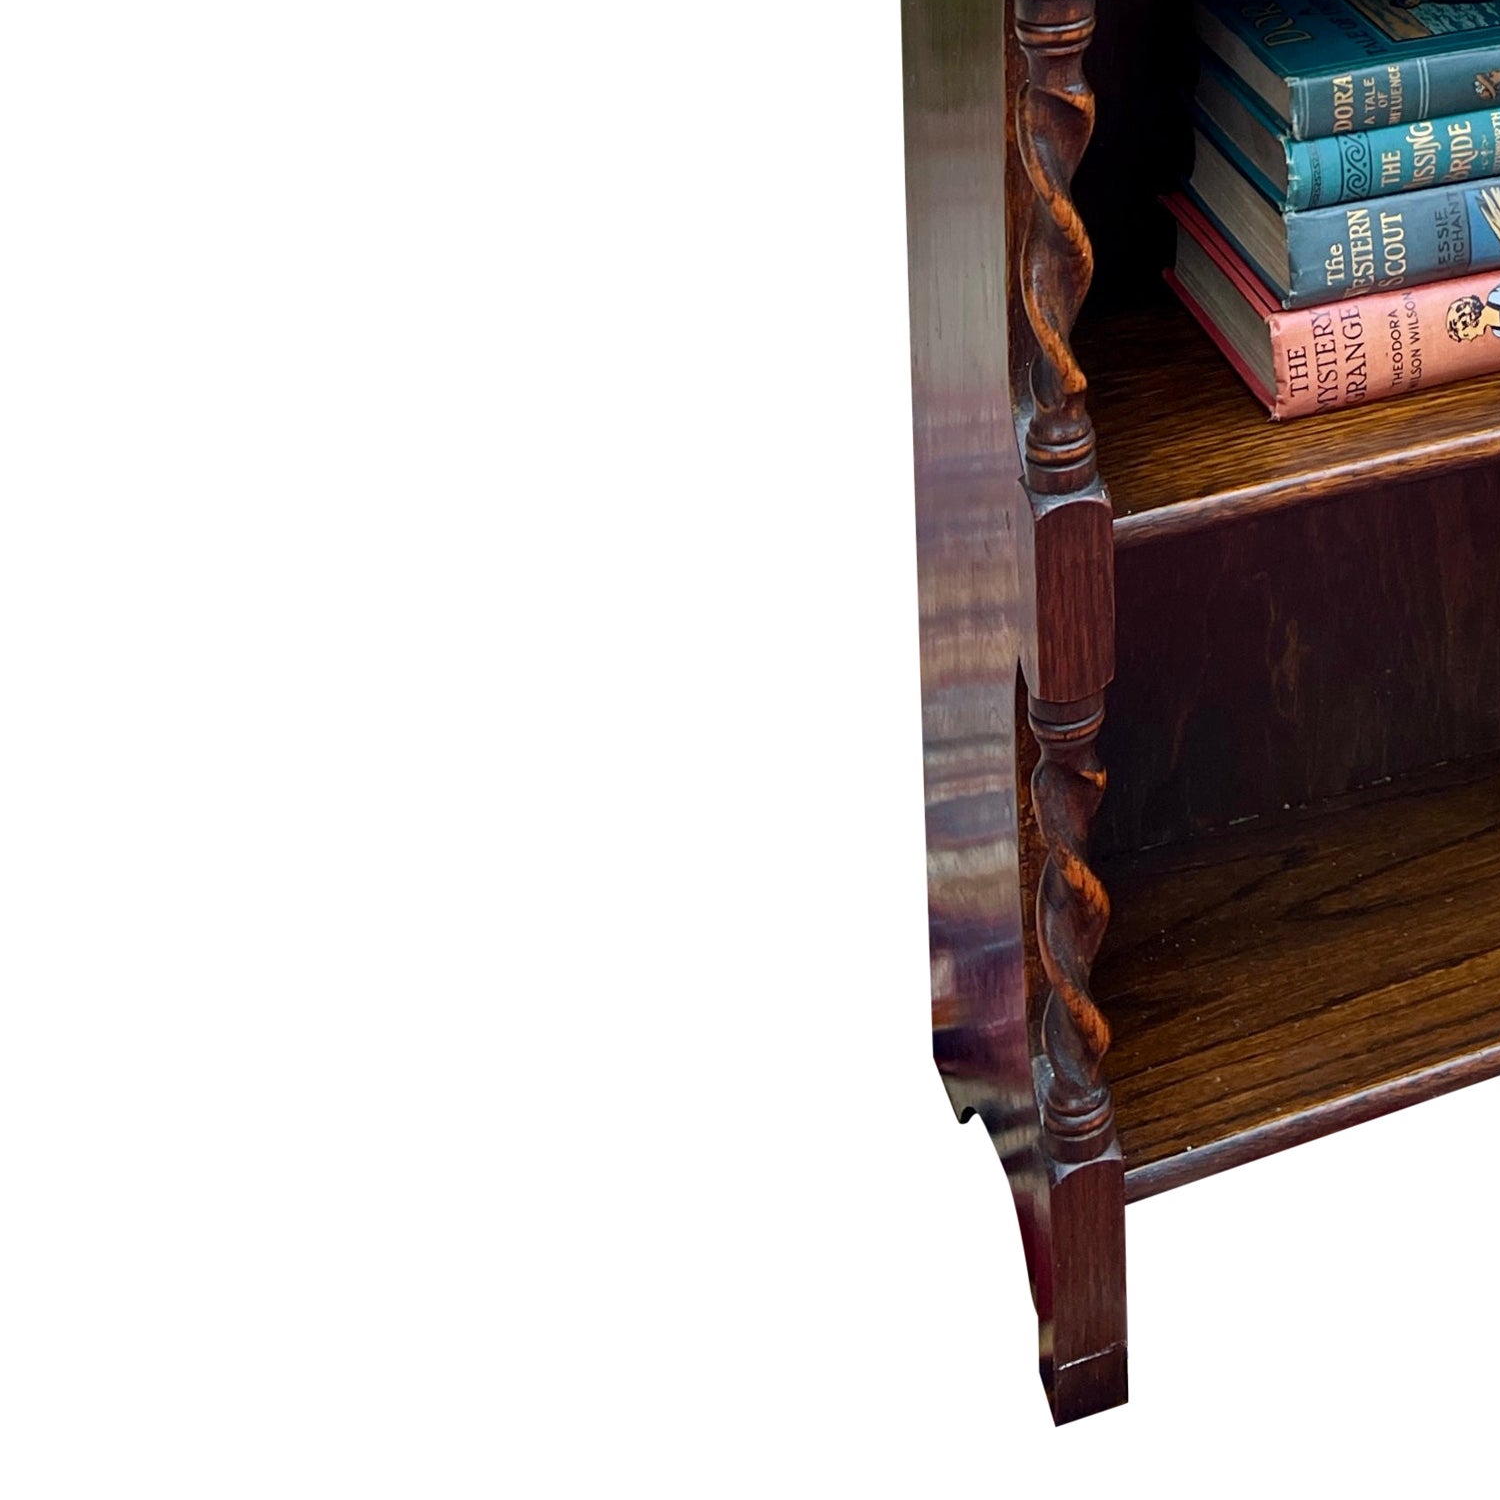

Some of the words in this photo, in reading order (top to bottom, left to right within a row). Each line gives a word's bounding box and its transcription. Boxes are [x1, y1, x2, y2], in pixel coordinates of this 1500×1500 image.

[1333, 74, 1354, 133] DORA
[1363, 76, 1377, 113] TALE
[1364, 115, 1376, 125] A
[1377, 91, 1388, 109] OF
[1382, 150, 1401, 187] THE
[1378, 212, 1407, 288] SCOUT
[1435, 207, 1451, 265] ESSIE
[1325, 243, 1345, 286] The
[1403, 292, 1421, 345] WILSON
[1287, 345, 1309, 397] THE
[1388, 308, 1403, 387] THEODORA
